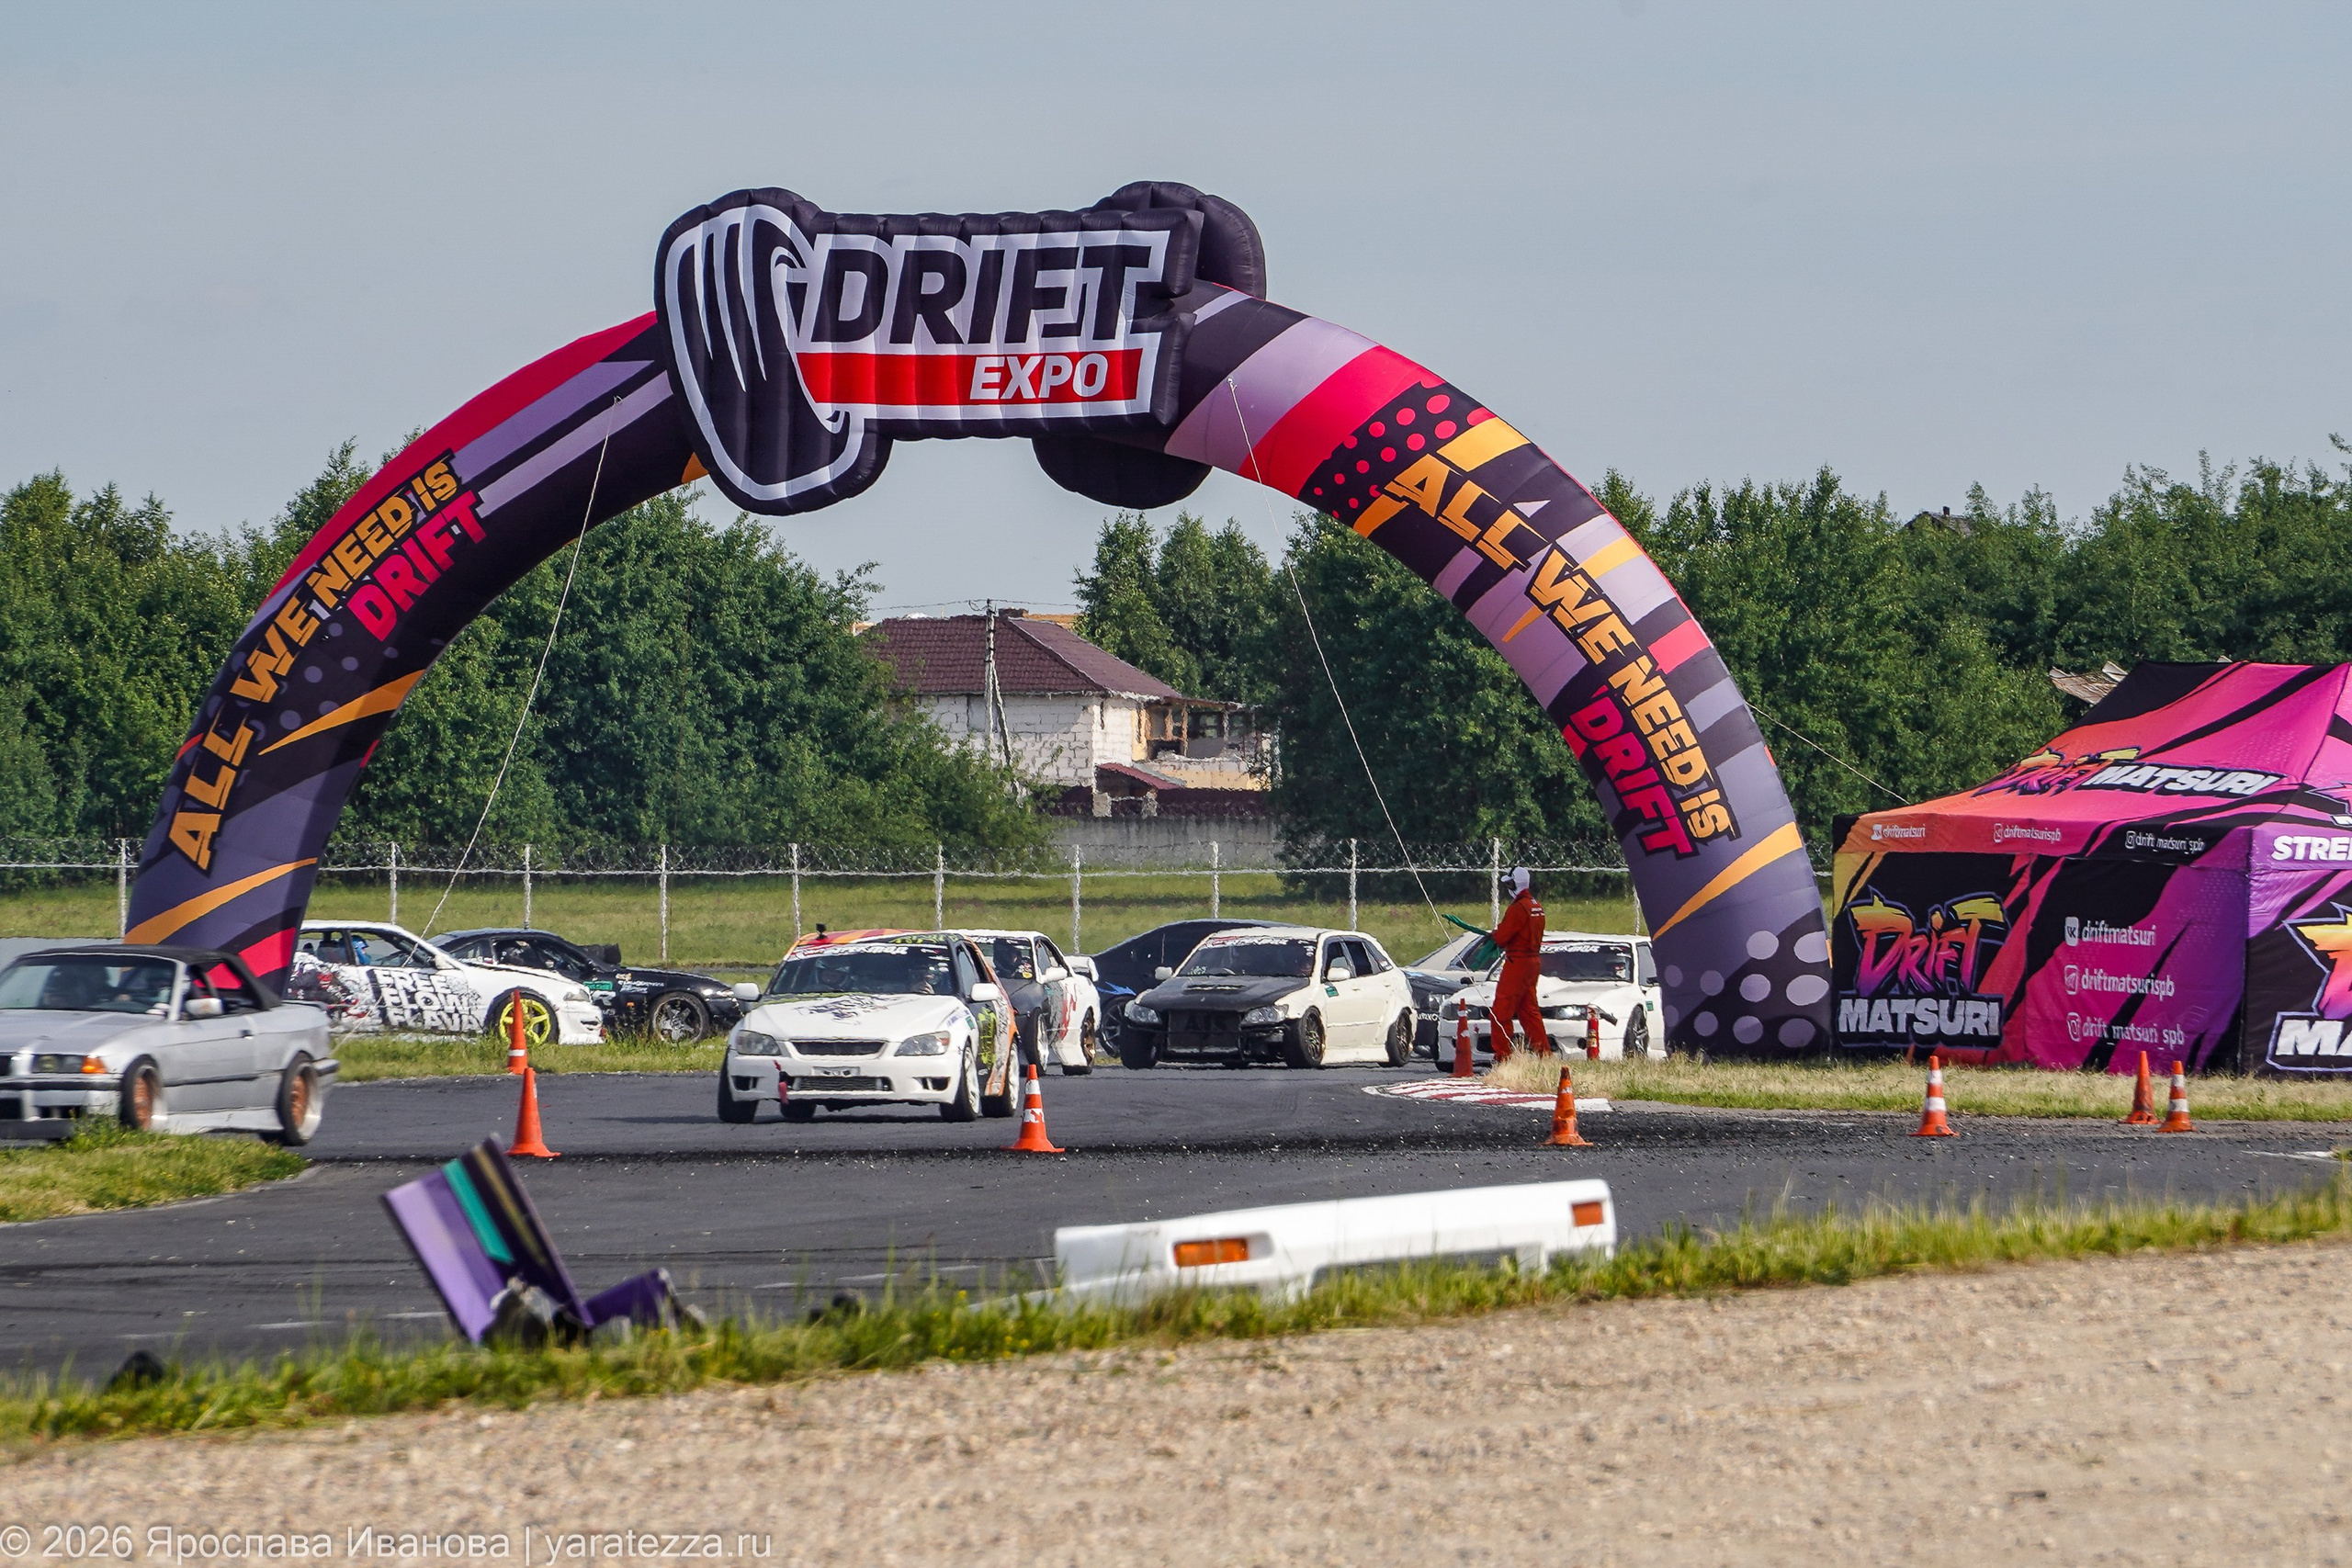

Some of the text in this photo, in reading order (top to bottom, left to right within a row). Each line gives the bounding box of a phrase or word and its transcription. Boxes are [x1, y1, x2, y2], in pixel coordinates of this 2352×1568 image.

[810, 243, 1152, 345] DRIFT
[969, 353, 1109, 400] EXPO
[345, 490, 487, 642] DRIFT
[168, 457, 458, 871] ALL WE NEED IS
[1384, 453, 1736, 840] ALL WE NEED IS
[1569, 695, 1694, 855] DRIFT
[2082, 765, 2283, 795] MATSURI
[2082, 919, 2156, 946] driftmatsuri
[374, 969, 452, 994] FREE
[380, 987, 471, 1013] FLOW
[2081, 968, 2175, 1001] driftmatsurispb
[1838, 998, 2000, 1036] MATSURI
[2082, 1016, 2185, 1050] drift_matsuri_spb
